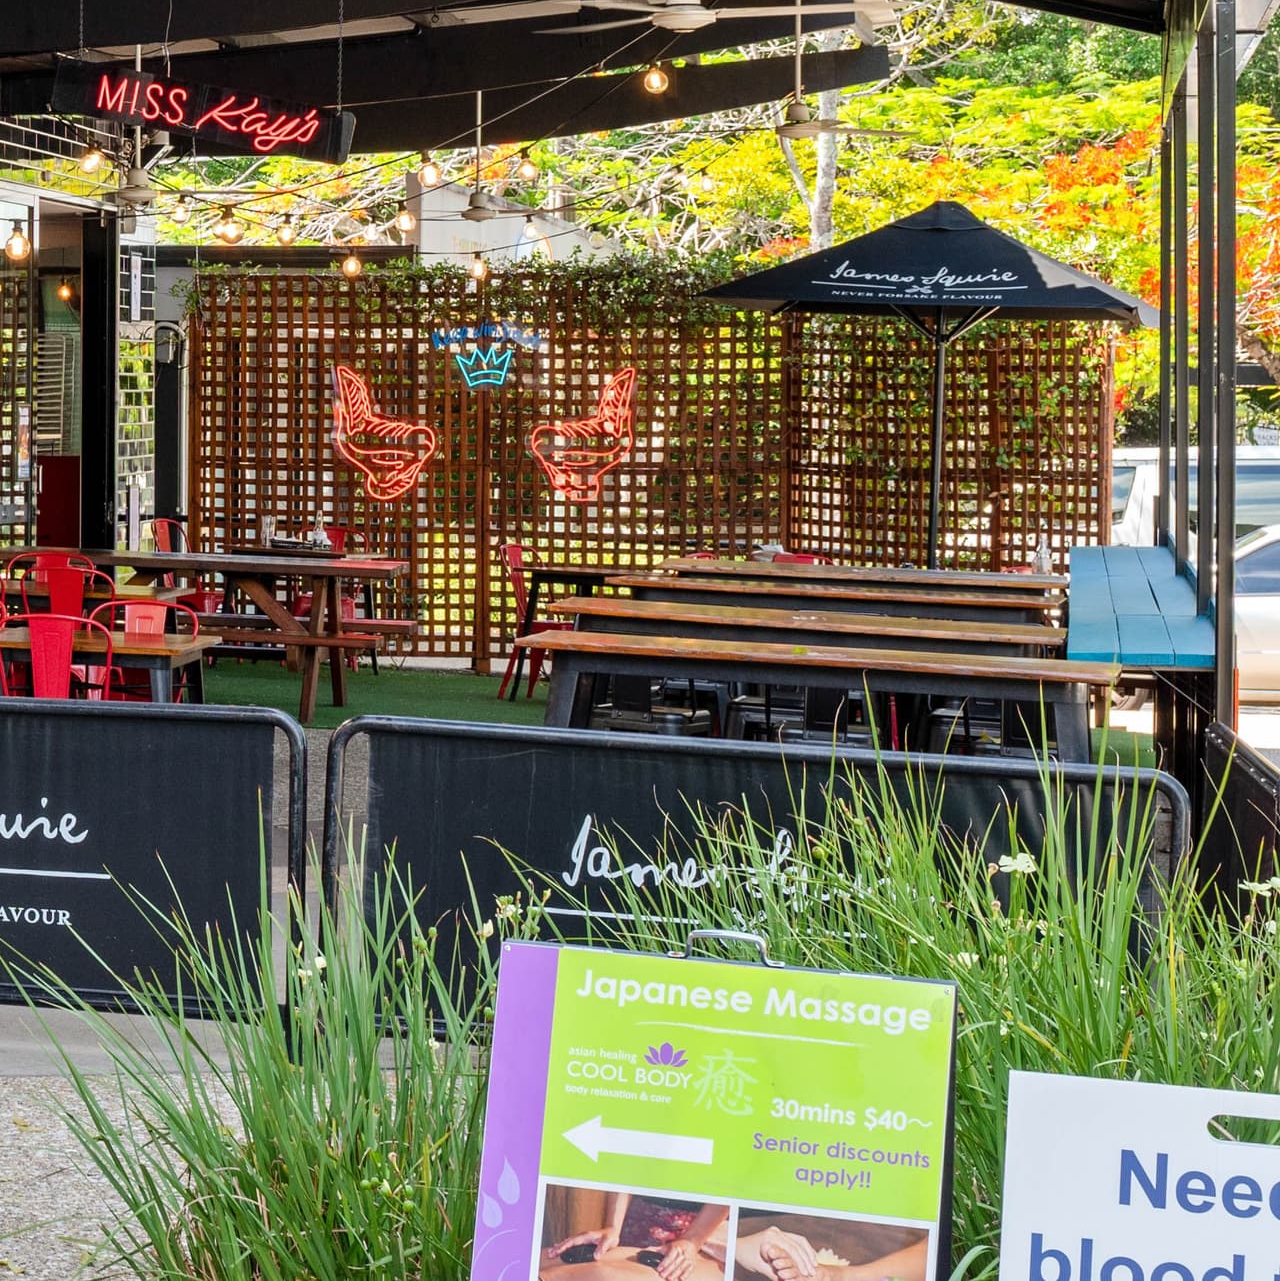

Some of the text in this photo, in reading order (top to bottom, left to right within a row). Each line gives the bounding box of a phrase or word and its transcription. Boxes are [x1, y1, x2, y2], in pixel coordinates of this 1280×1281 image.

[96, 74, 187, 126] MISS
[830, 259, 1019, 286] James Squire
[832, 290, 874, 298] NEVER
[878, 292, 939, 300] FORSAKE
[576, 968, 932, 1037] Japanese Massage
[568, 1046, 637, 1064] asian healing
[566, 1060, 693, 1089] COOL BODY
[565, 1084, 589, 1096] body
[650, 1094, 672, 1104] care
[770, 1096, 856, 1127] 30mins
[752, 1132, 931, 1169] Senior discounts
[795, 1164, 872, 1192] apply!!
